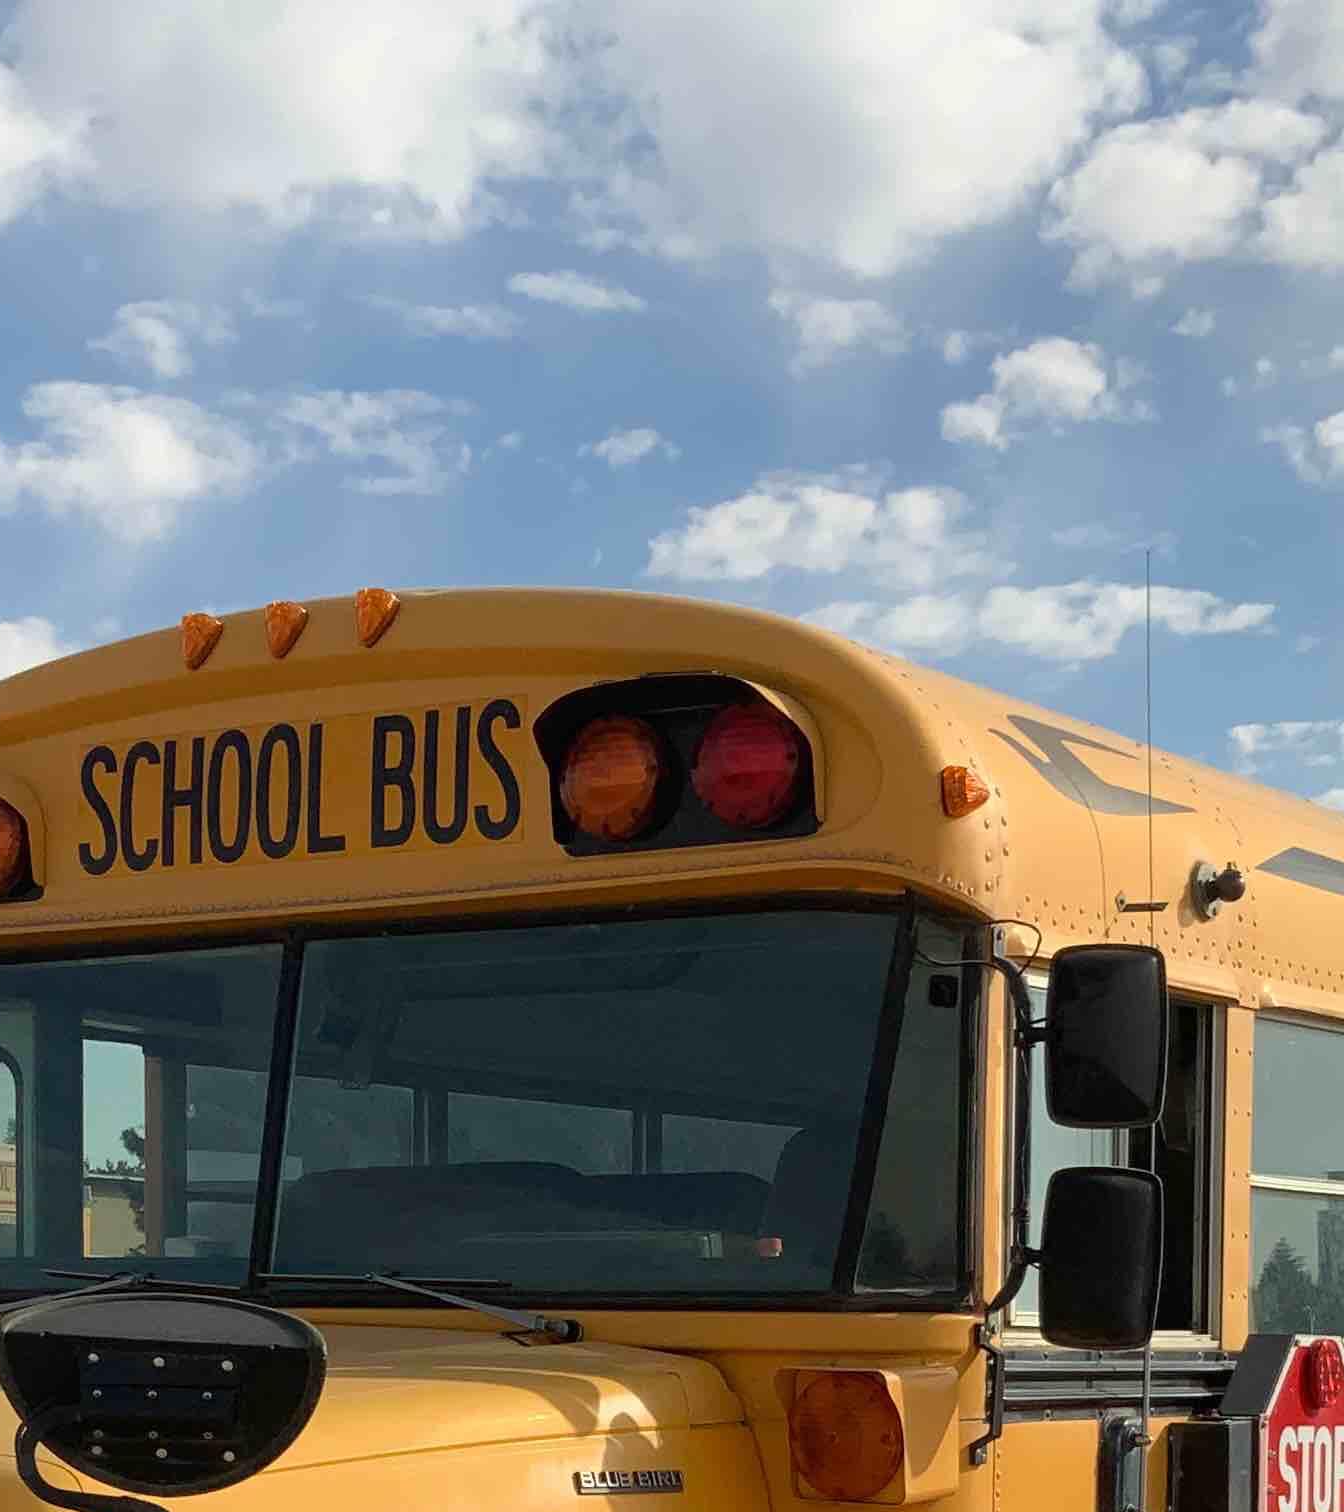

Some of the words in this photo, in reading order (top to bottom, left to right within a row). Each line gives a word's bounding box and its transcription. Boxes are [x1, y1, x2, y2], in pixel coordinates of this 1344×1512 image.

[78, 720, 346, 876] SCHOOL
[370, 698, 522, 849] BUS
[580, 1471, 633, 1488] BLUE
